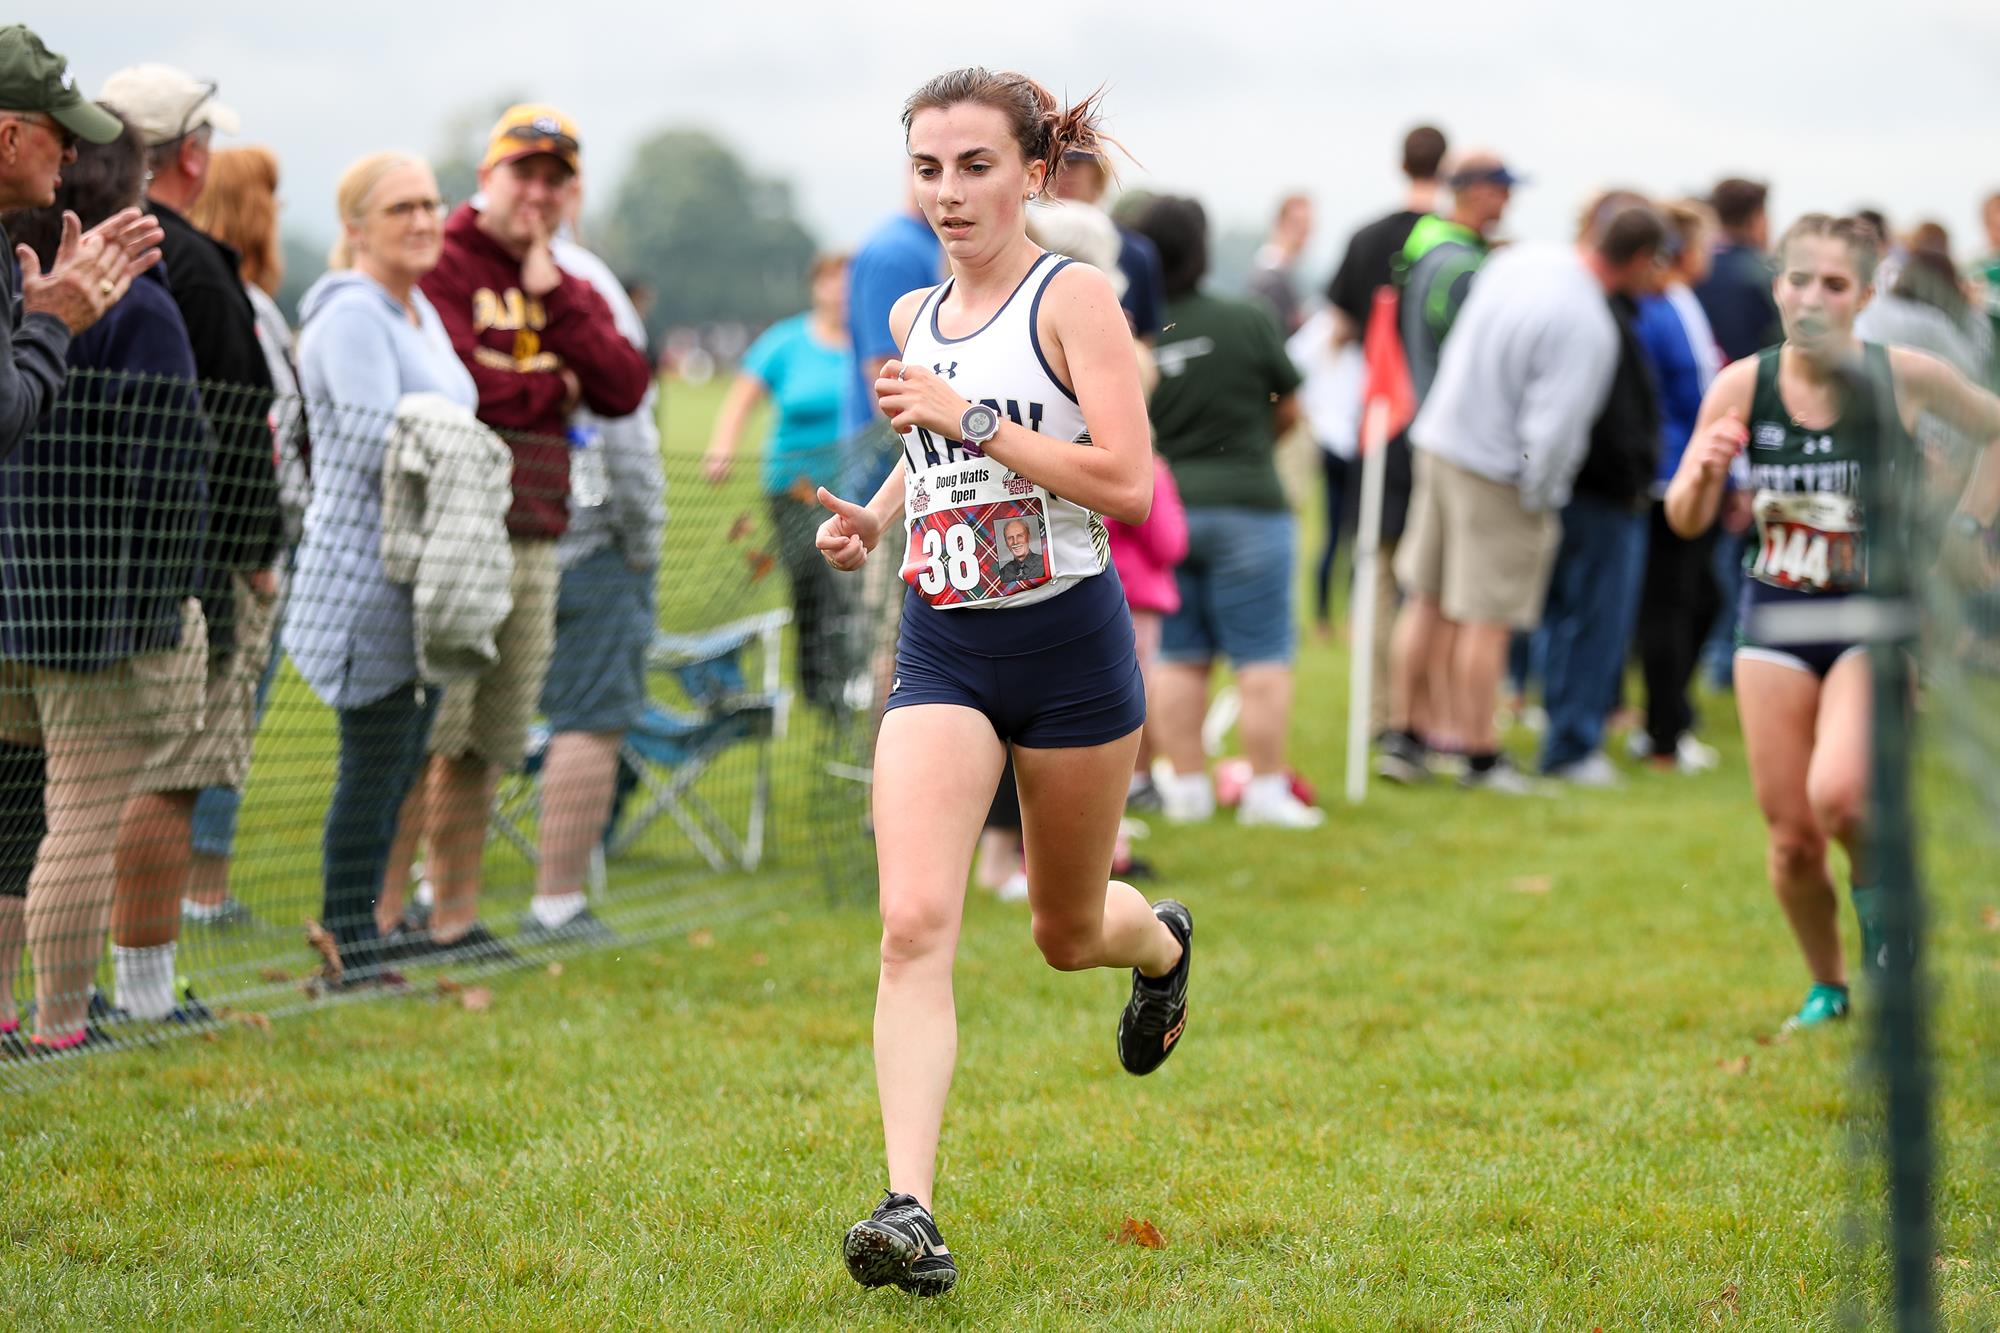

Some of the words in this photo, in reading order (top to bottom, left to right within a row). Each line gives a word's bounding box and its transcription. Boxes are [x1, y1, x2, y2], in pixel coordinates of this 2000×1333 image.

[936, 475, 957, 489] Doug
[960, 469, 989, 485] Watts
[1003, 478, 1033, 489] FIGHTIN
[951, 488, 976, 504] Open
[1009, 484, 1034, 495] SCOTS
[918, 523, 981, 595] 38
